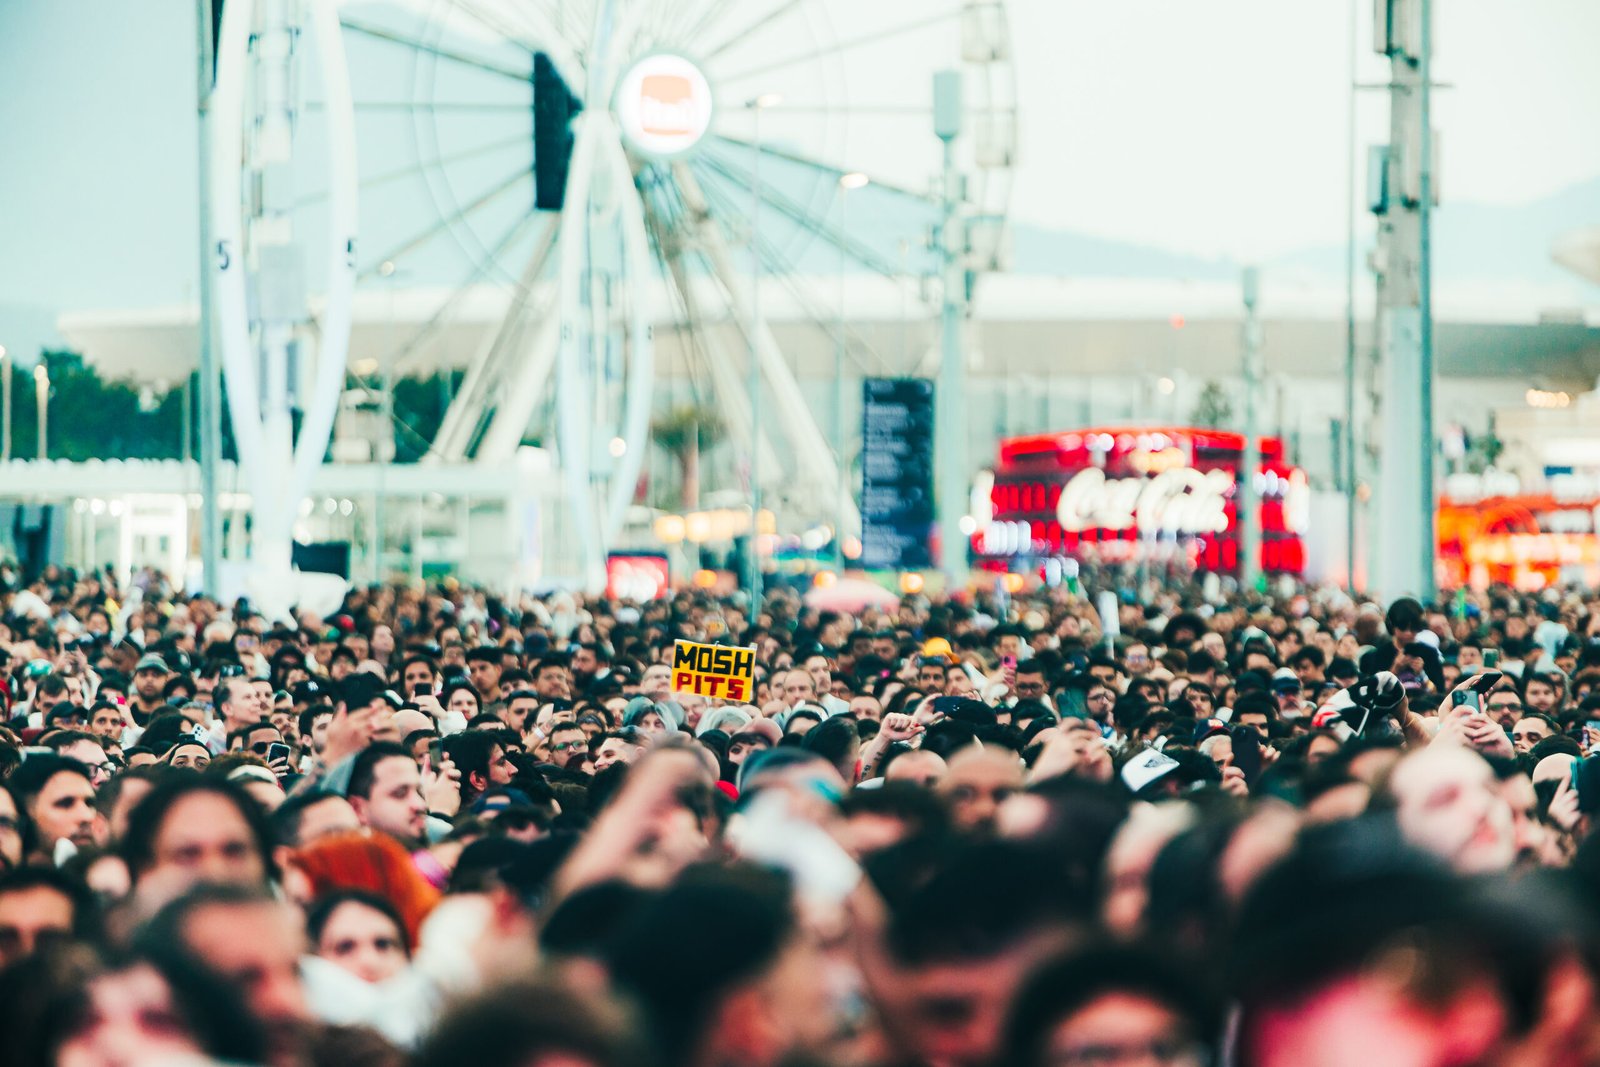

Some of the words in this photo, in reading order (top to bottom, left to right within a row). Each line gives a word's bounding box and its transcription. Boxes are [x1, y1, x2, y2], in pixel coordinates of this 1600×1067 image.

[217, 239, 230, 270] 5
[674, 644, 754, 678] MOSH
[676, 672, 744, 700] PITS
